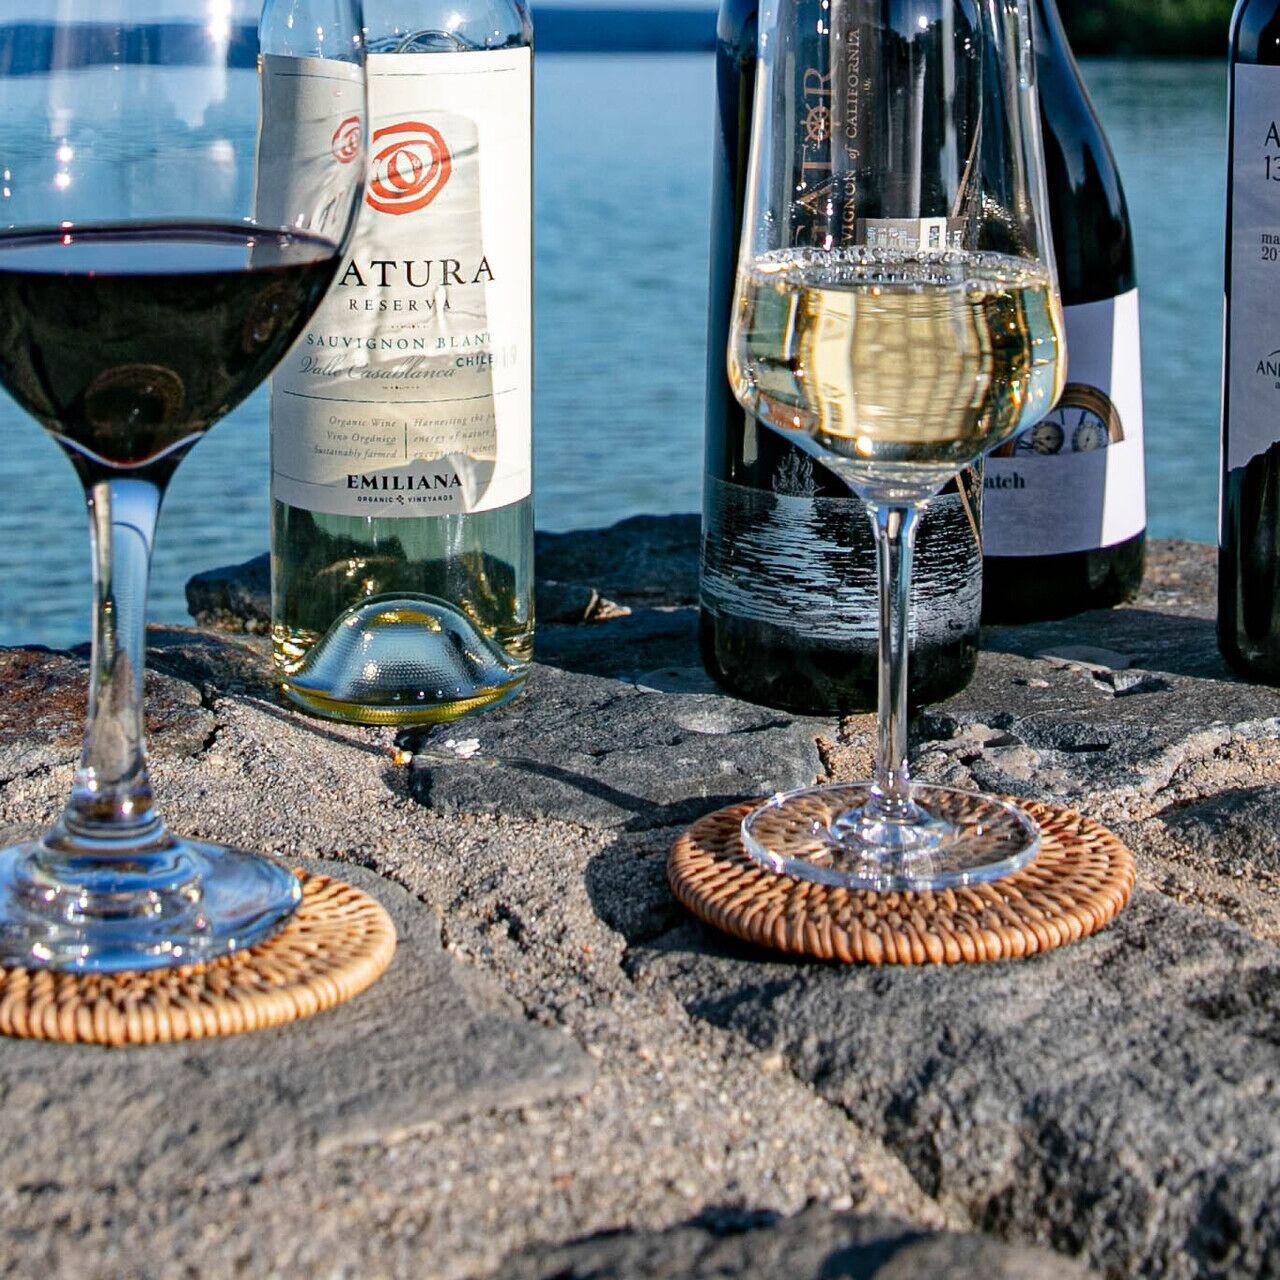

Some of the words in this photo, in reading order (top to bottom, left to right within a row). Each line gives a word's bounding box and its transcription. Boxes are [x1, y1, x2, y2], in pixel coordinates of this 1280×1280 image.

[845, 28, 861, 139] CALIFORNIA
[844, 142, 860, 160] of
[841, 170, 858, 245] VIGNON
[338, 255, 496, 288] ATURA
[349, 298, 451, 312] RESERVA
[307, 333, 425, 349] SAUVIGNON
[299, 353, 347, 377] Valle
[347, 355, 457, 380] Casablanca
[456, 353, 494, 368] CHILE
[329, 416, 366, 427] Organic
[371, 418, 396, 427] Wine
[347, 473, 463, 490] EMILIANA
[983, 471, 1025, 489] atch
[408, 495, 453, 503] VINEYARDS
